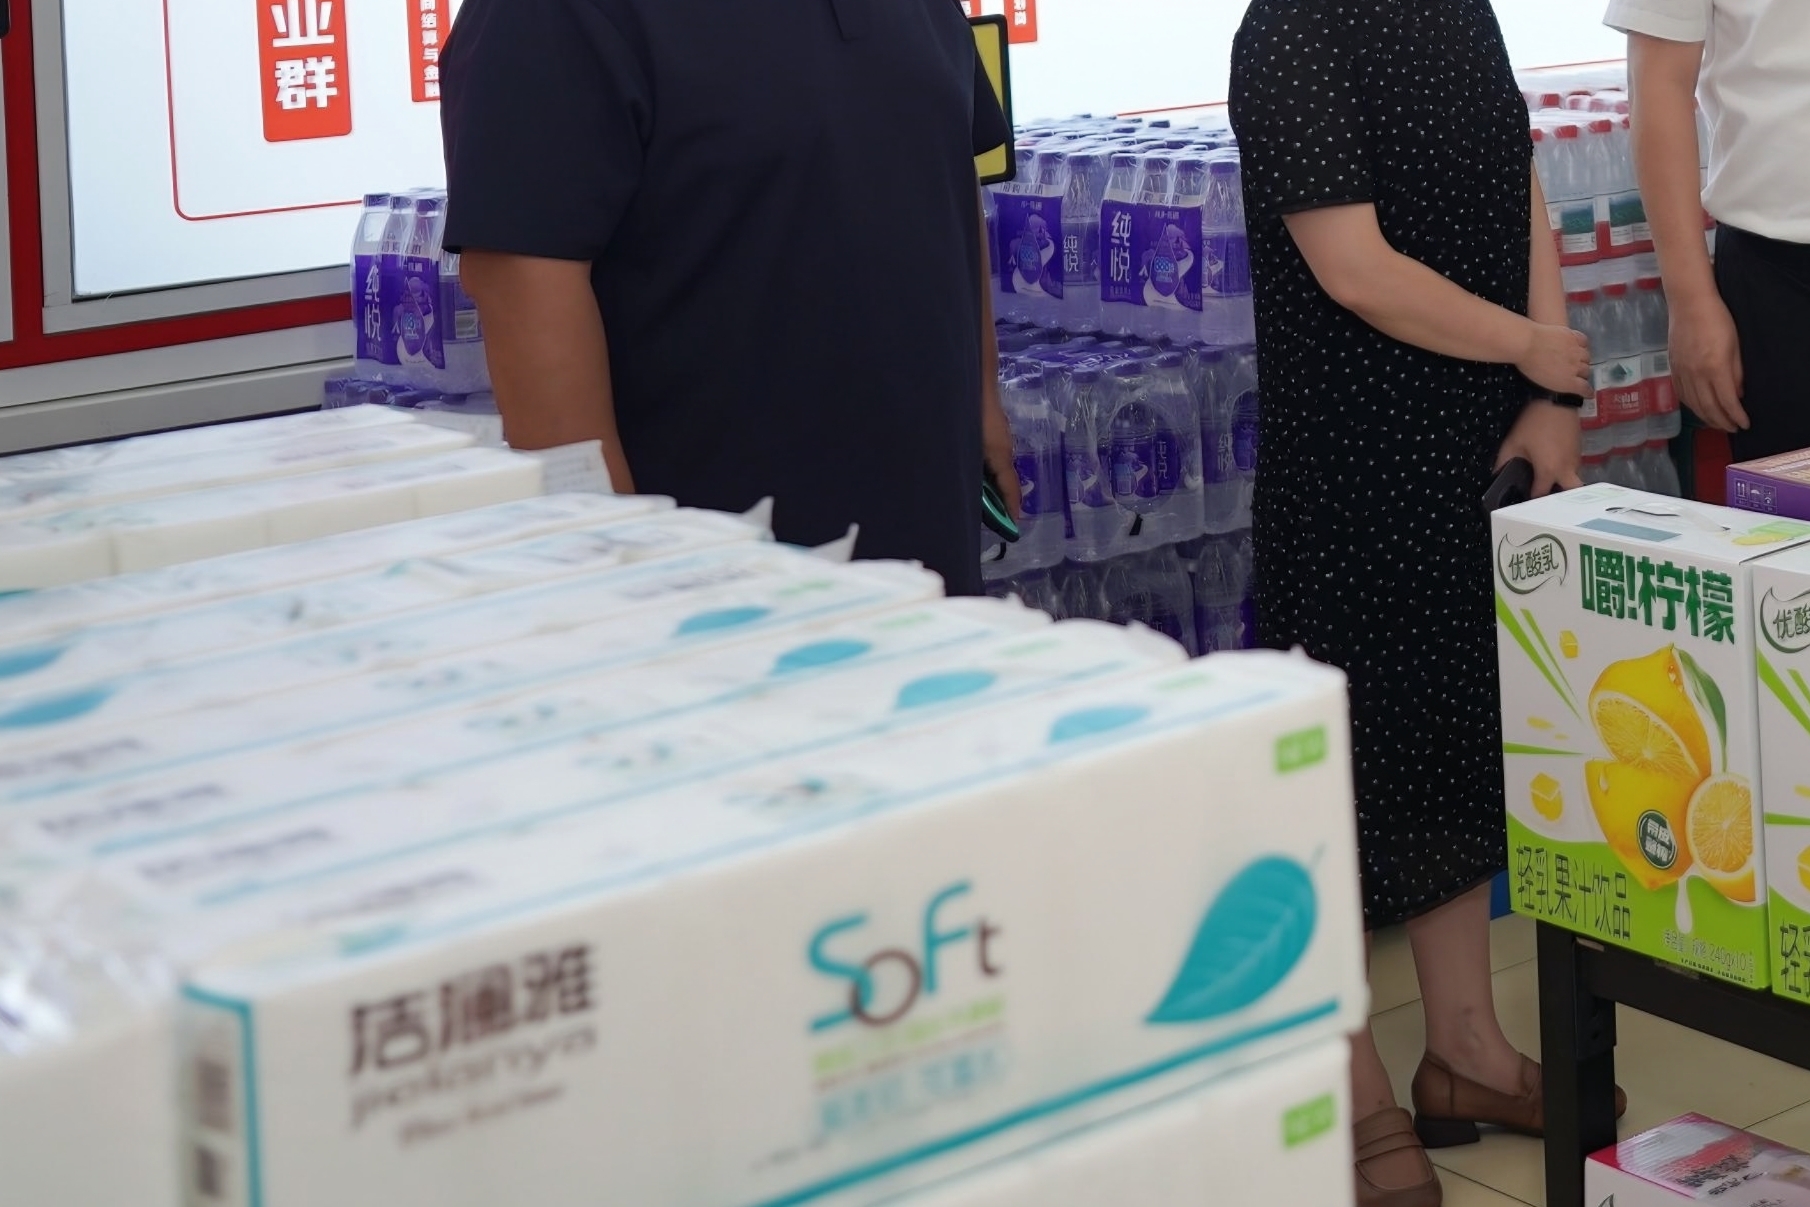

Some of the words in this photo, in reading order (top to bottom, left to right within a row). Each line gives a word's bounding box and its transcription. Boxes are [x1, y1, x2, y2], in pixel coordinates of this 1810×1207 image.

[1110, 209, 1132, 284] 纯悦
[1507, 539, 1562, 582] 优酸乳
[1515, 840, 1632, 943] 轻乳果汁饮品
